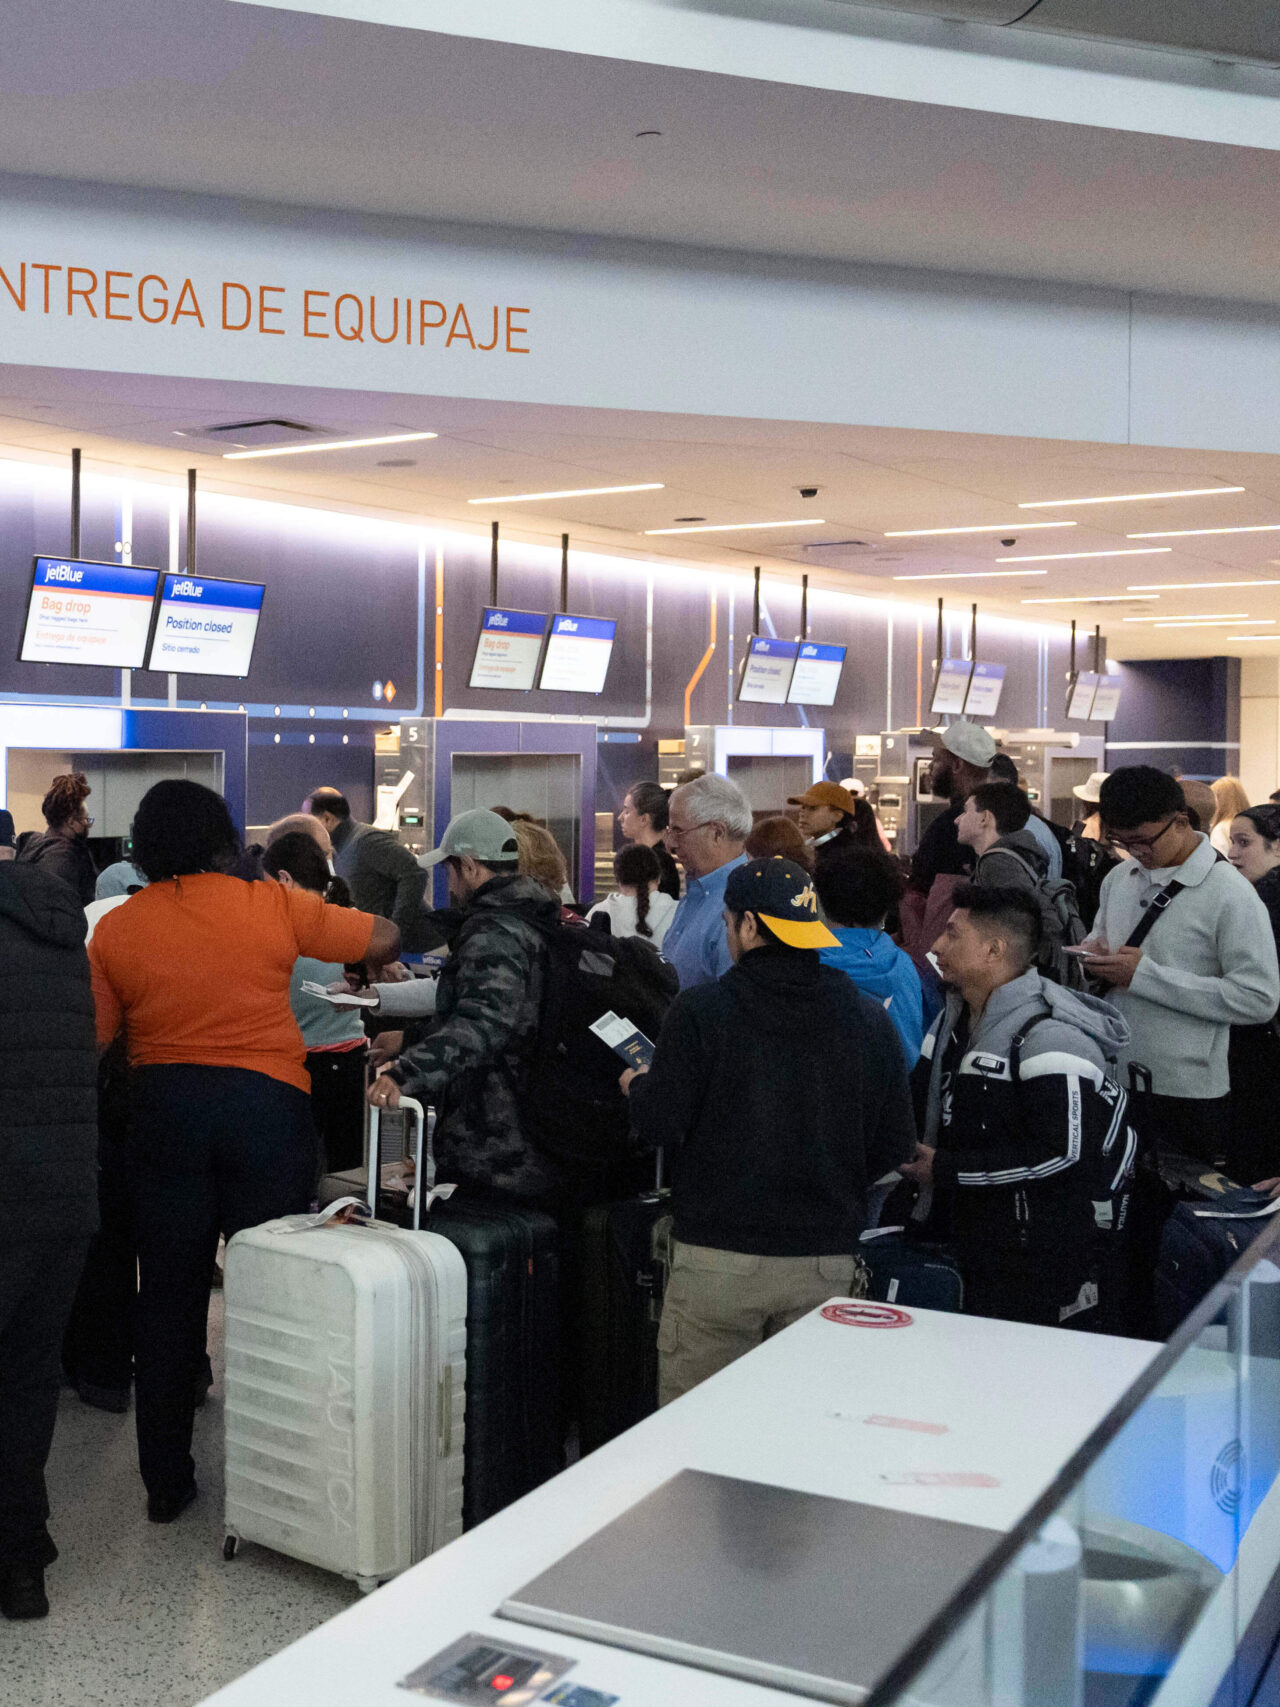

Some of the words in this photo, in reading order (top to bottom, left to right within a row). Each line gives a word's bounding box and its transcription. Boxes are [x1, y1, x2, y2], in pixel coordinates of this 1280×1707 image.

[221, 281, 286, 335] DE
[303, 289, 531, 354] EQUIPAJE
[44, 564, 83, 583] jetBlue
[170, 579, 203, 597] jetBlue
[41, 597, 63, 614] Bag
[65, 600, 92, 615] drop
[166, 616, 202, 631] Position
[204, 620, 234, 633] closed
[409, 726, 418, 742] 5
[692, 734, 700, 747] 7
[886, 738, 895, 749] 9
[1071, 1090, 1079, 1121] SPORTS
[326, 1330, 353, 1535] NAUTICA
